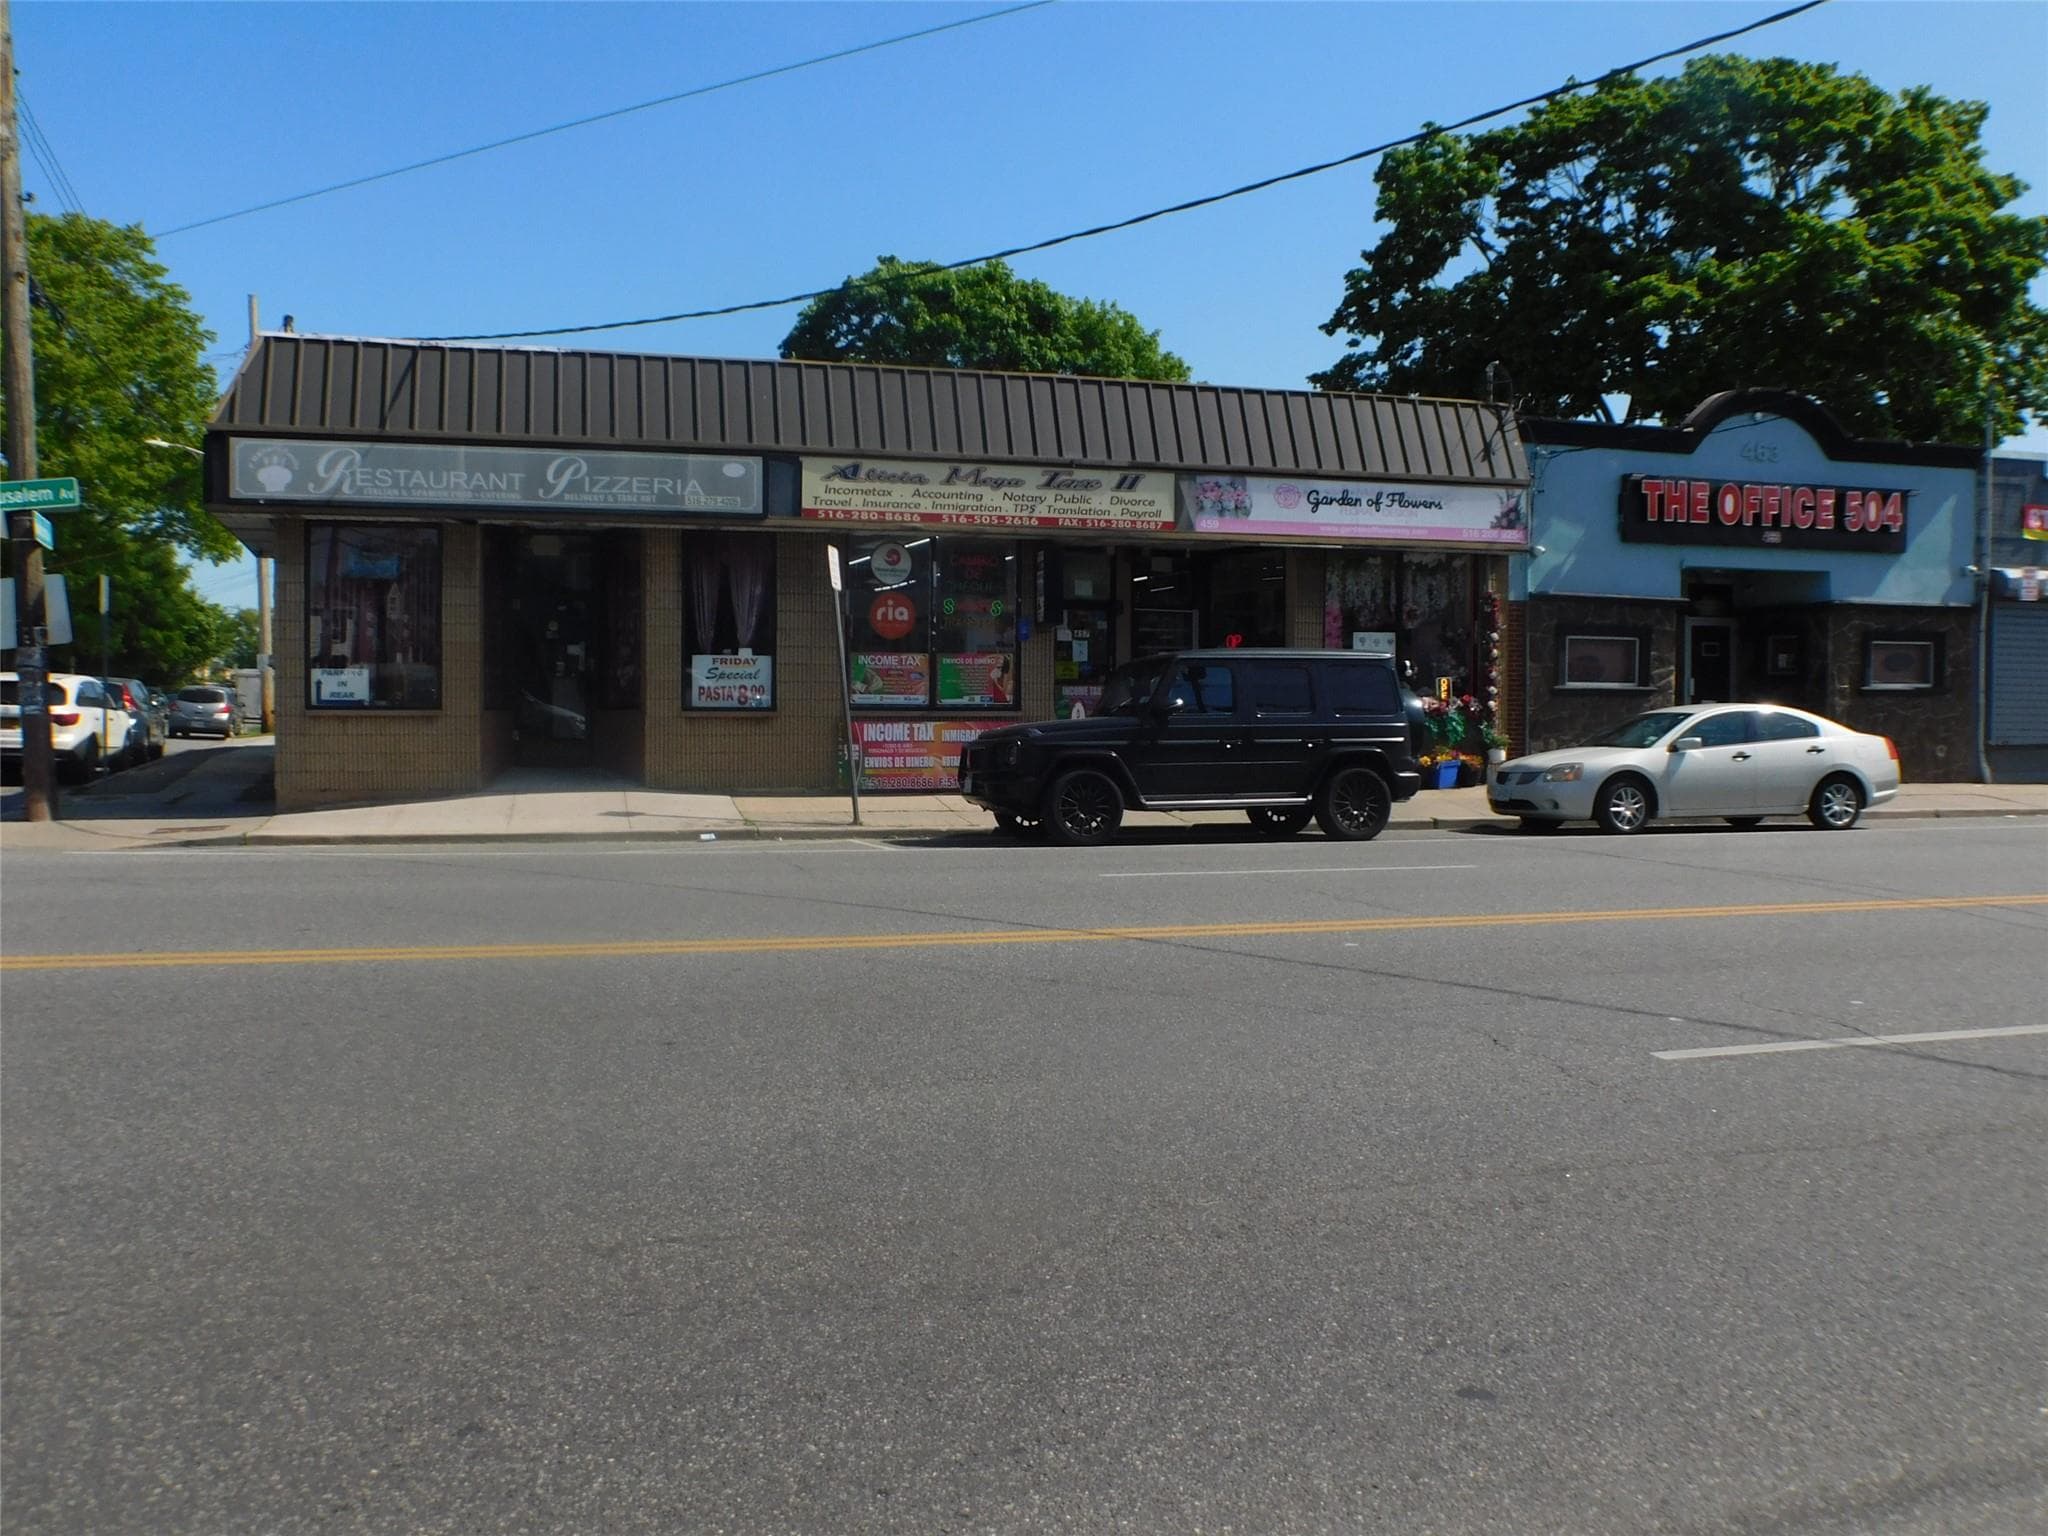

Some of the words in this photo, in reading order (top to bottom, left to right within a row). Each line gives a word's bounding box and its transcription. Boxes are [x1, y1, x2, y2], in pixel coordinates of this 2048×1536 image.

[911, 488, 984, 502] Accounting
[1002, 491, 1047, 505] Notary
[1054, 493, 1092, 506] Public
[1110, 495, 1156, 507] Divorce
[1307, 489, 1362, 513] Garden
[1366, 491, 1384, 512] of
[1386, 492, 1443, 510] Flowers
[1642, 480, 1710, 524] THE
[1717, 482, 1836, 530] OFFICE
[1844, 490, 1904, 533] 504
[812, 496, 851, 507] Travel
[862, 498, 921, 510] Insurance
[1013, 504, 1035, 515] TPS
[1047, 504, 1111, 517] Translation
[1120, 507, 1162, 519] Payroll
[1200, 519, 1219, 529] 459
[876, 599, 909, 621] ria
[712, 657, 759, 666] FRIDAY
[858, 655, 898, 665] INCOME
[901, 655, 921, 666] TAX
[705, 667, 761, 682] Special
[1440, 678, 1448, 700] OPE
[863, 722, 910, 742] INCOME
[912, 723, 935, 742] TAX
[864, 756, 893, 768] ENVIOS
[895, 756, 904, 768] DE
